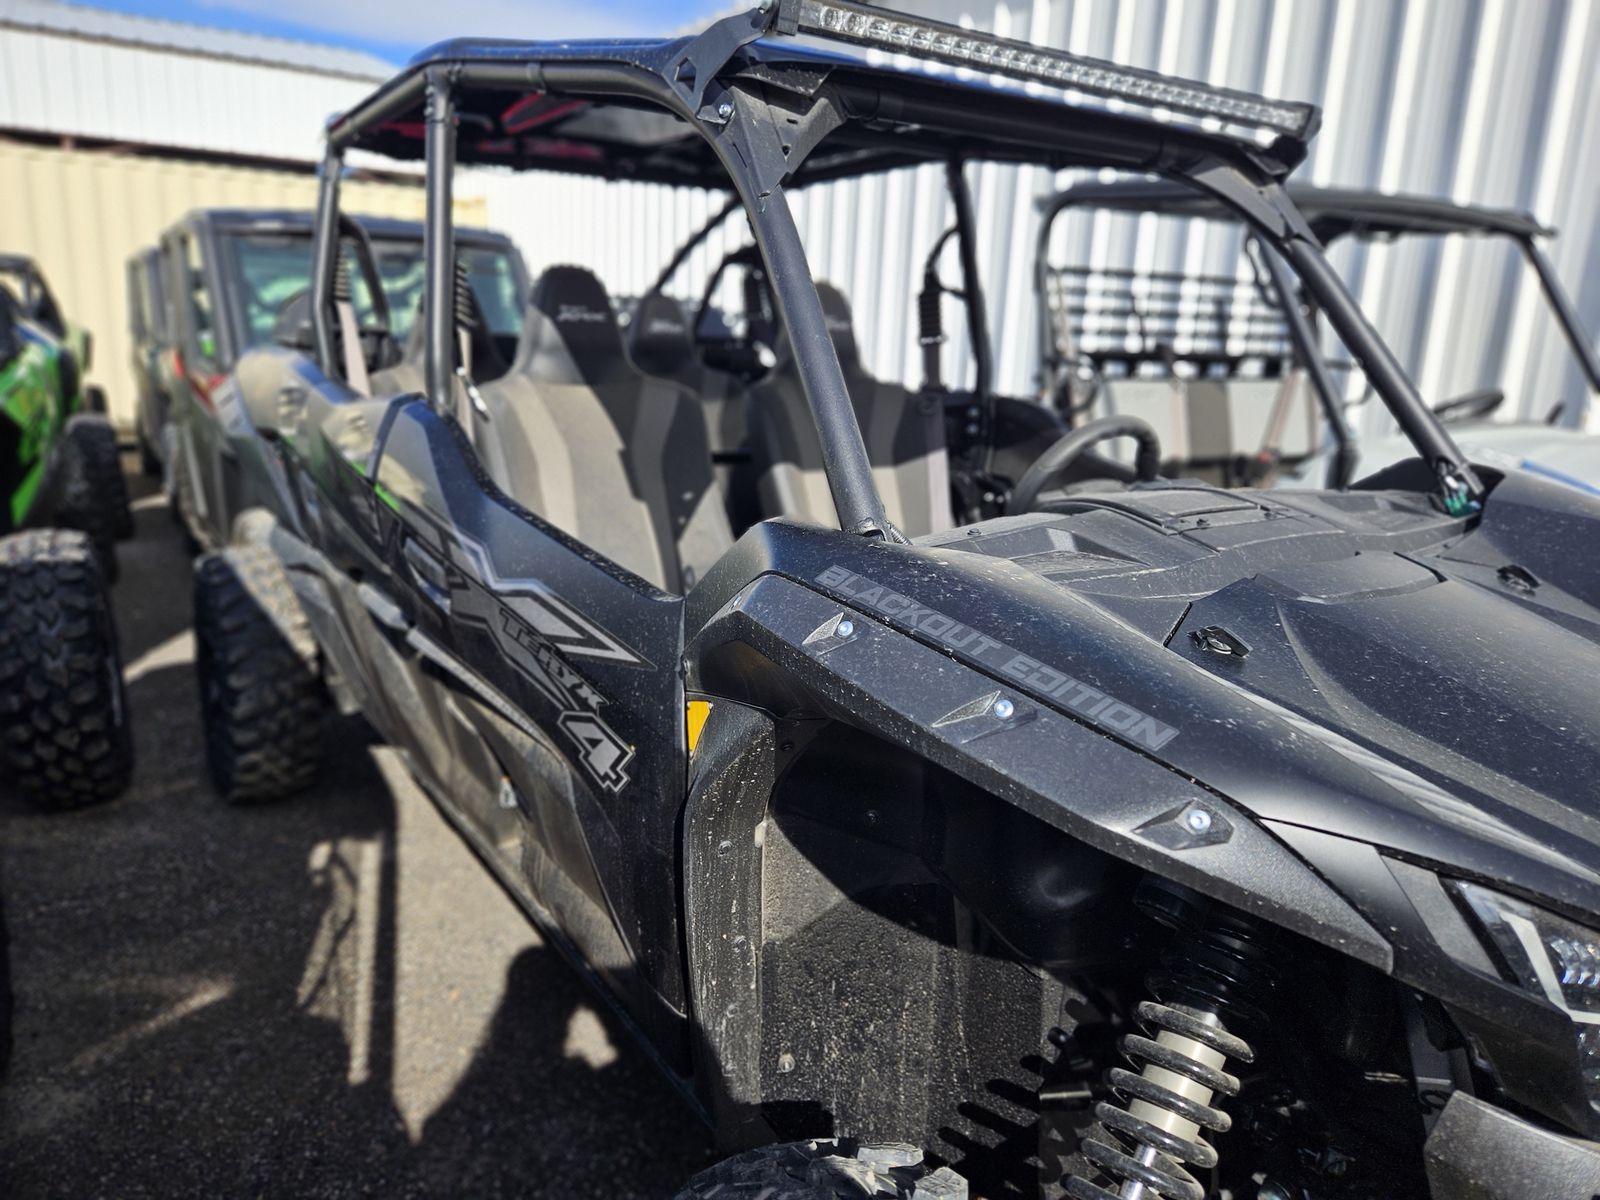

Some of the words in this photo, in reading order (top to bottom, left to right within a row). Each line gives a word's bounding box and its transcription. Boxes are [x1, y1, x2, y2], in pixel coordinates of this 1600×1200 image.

[814, 565, 1002, 656] BLACKOUT
[1001, 654, 1178, 750] EDITION
[559, 712, 634, 791] 4
